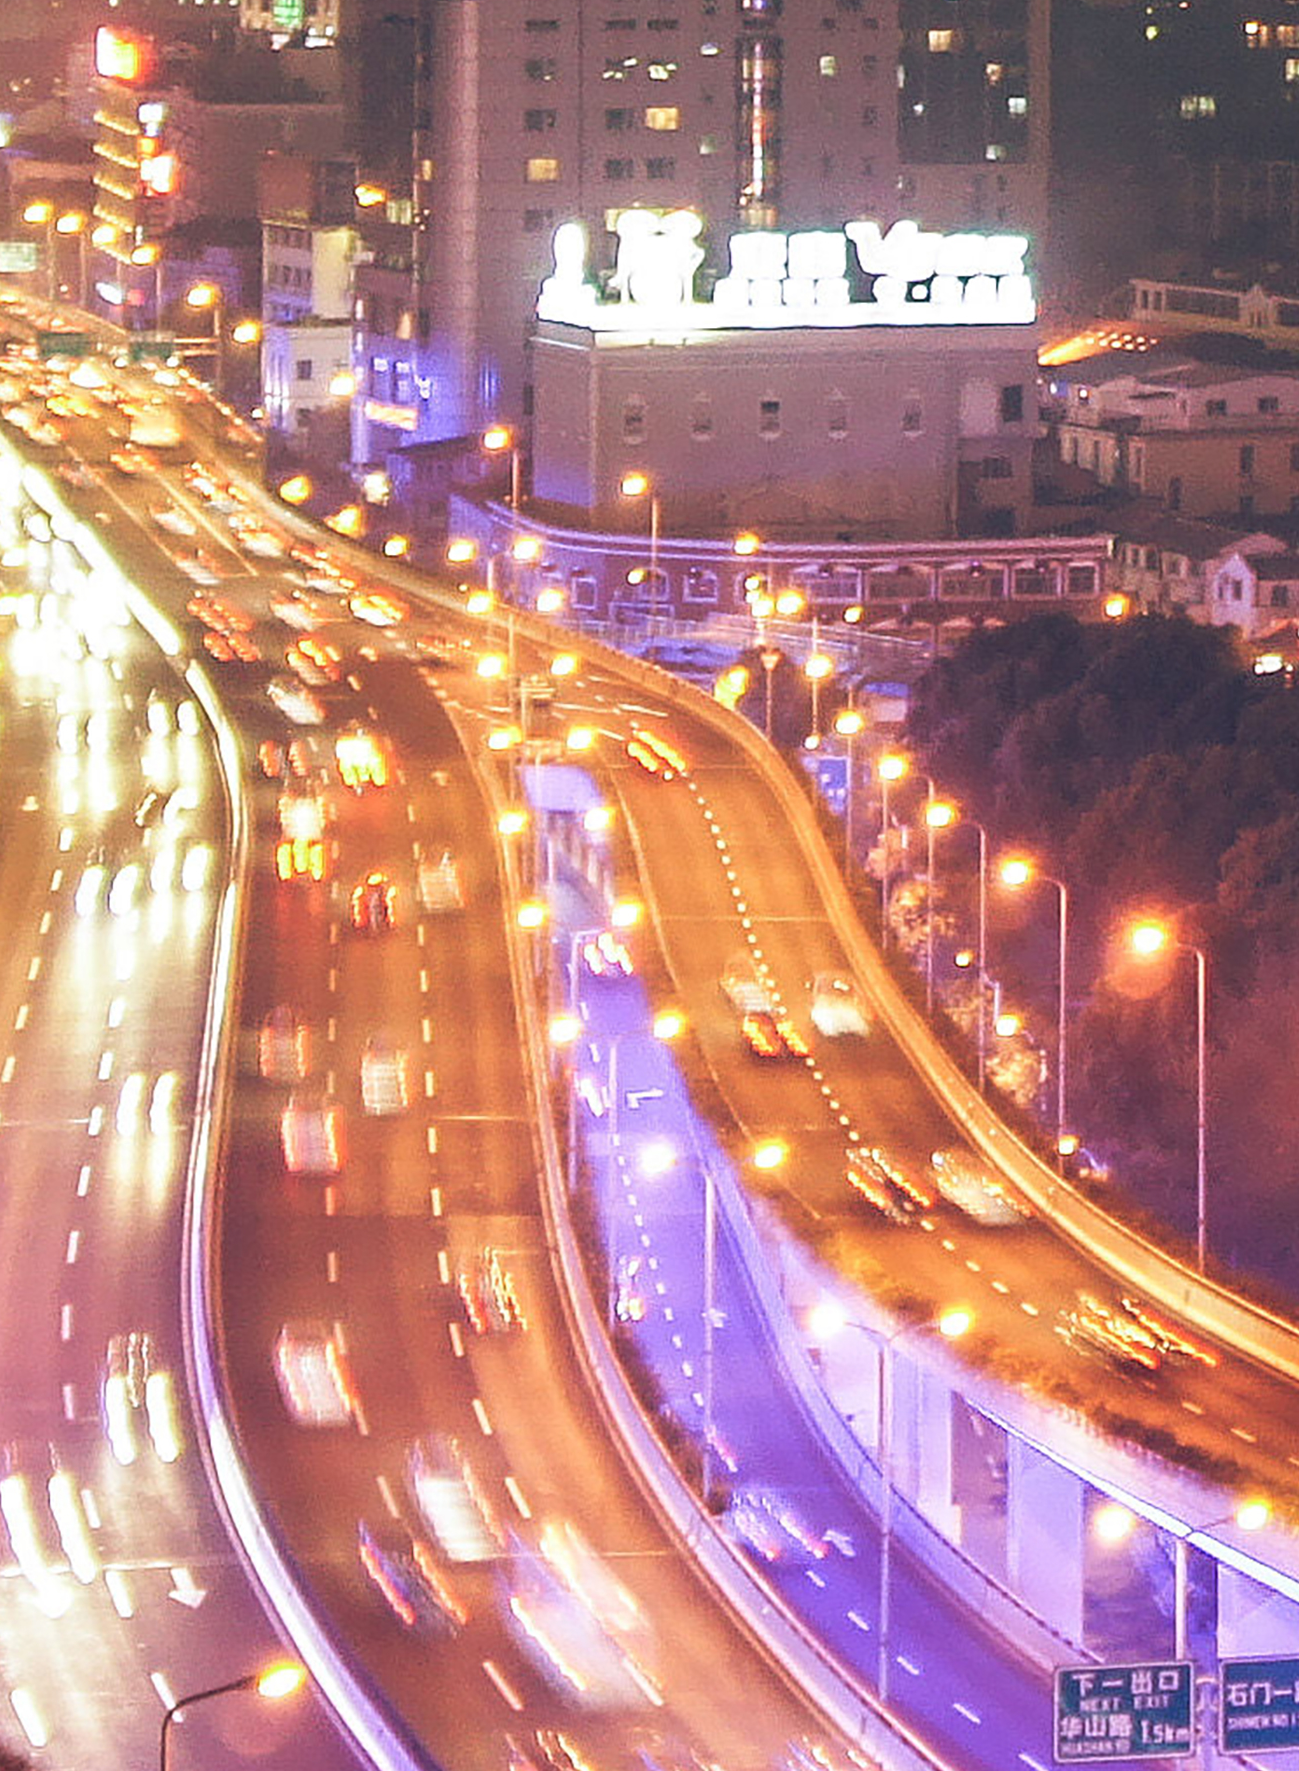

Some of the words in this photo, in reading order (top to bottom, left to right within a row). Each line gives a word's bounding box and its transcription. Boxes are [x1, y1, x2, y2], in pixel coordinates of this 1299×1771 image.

[1072, 1670, 1179, 1697] 下一出口
[1227, 1681, 1299, 1706] 石门一
[1080, 1697, 1120, 1712] NEXT
[1133, 1695, 1169, 1709] EXIT
[1060, 1714, 1132, 1739] 华山路
